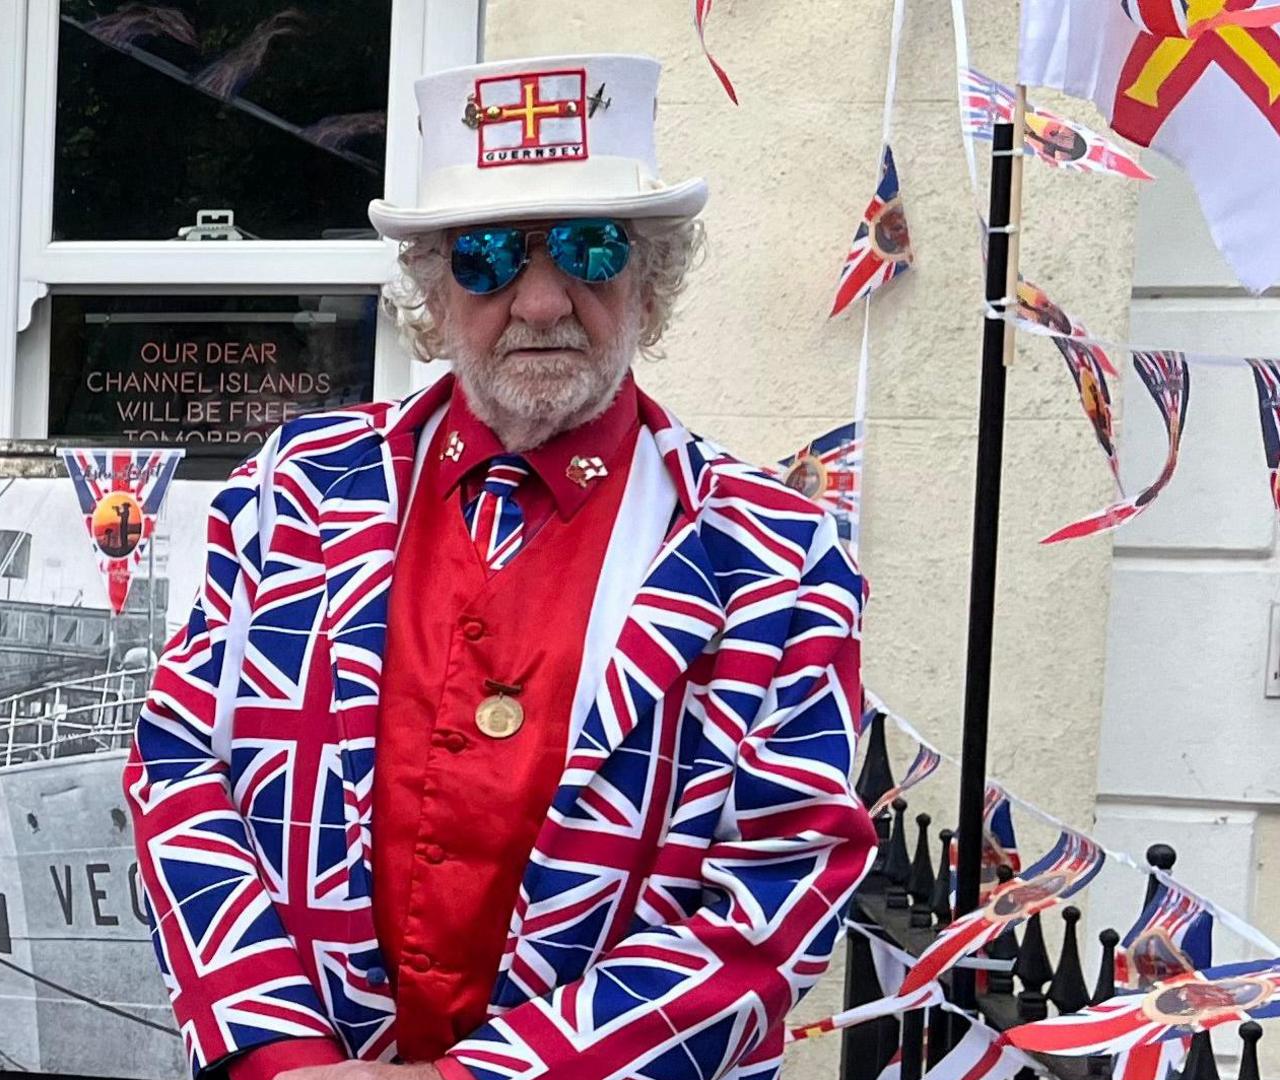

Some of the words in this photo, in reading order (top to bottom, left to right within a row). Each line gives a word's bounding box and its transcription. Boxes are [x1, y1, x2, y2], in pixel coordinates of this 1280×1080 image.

[485, 146, 582, 161] GUERNSEY
[140, 342, 198, 364] OUR
[206, 342, 277, 364] DEAR
[86, 371, 213, 393] CHANNEL
[220, 371, 330, 394] ISLANDS
[117, 401, 180, 422] WILL
[187, 401, 222, 423] BE
[230, 401, 299, 424] FREE
[123, 430, 269, 443] TOMORRO
